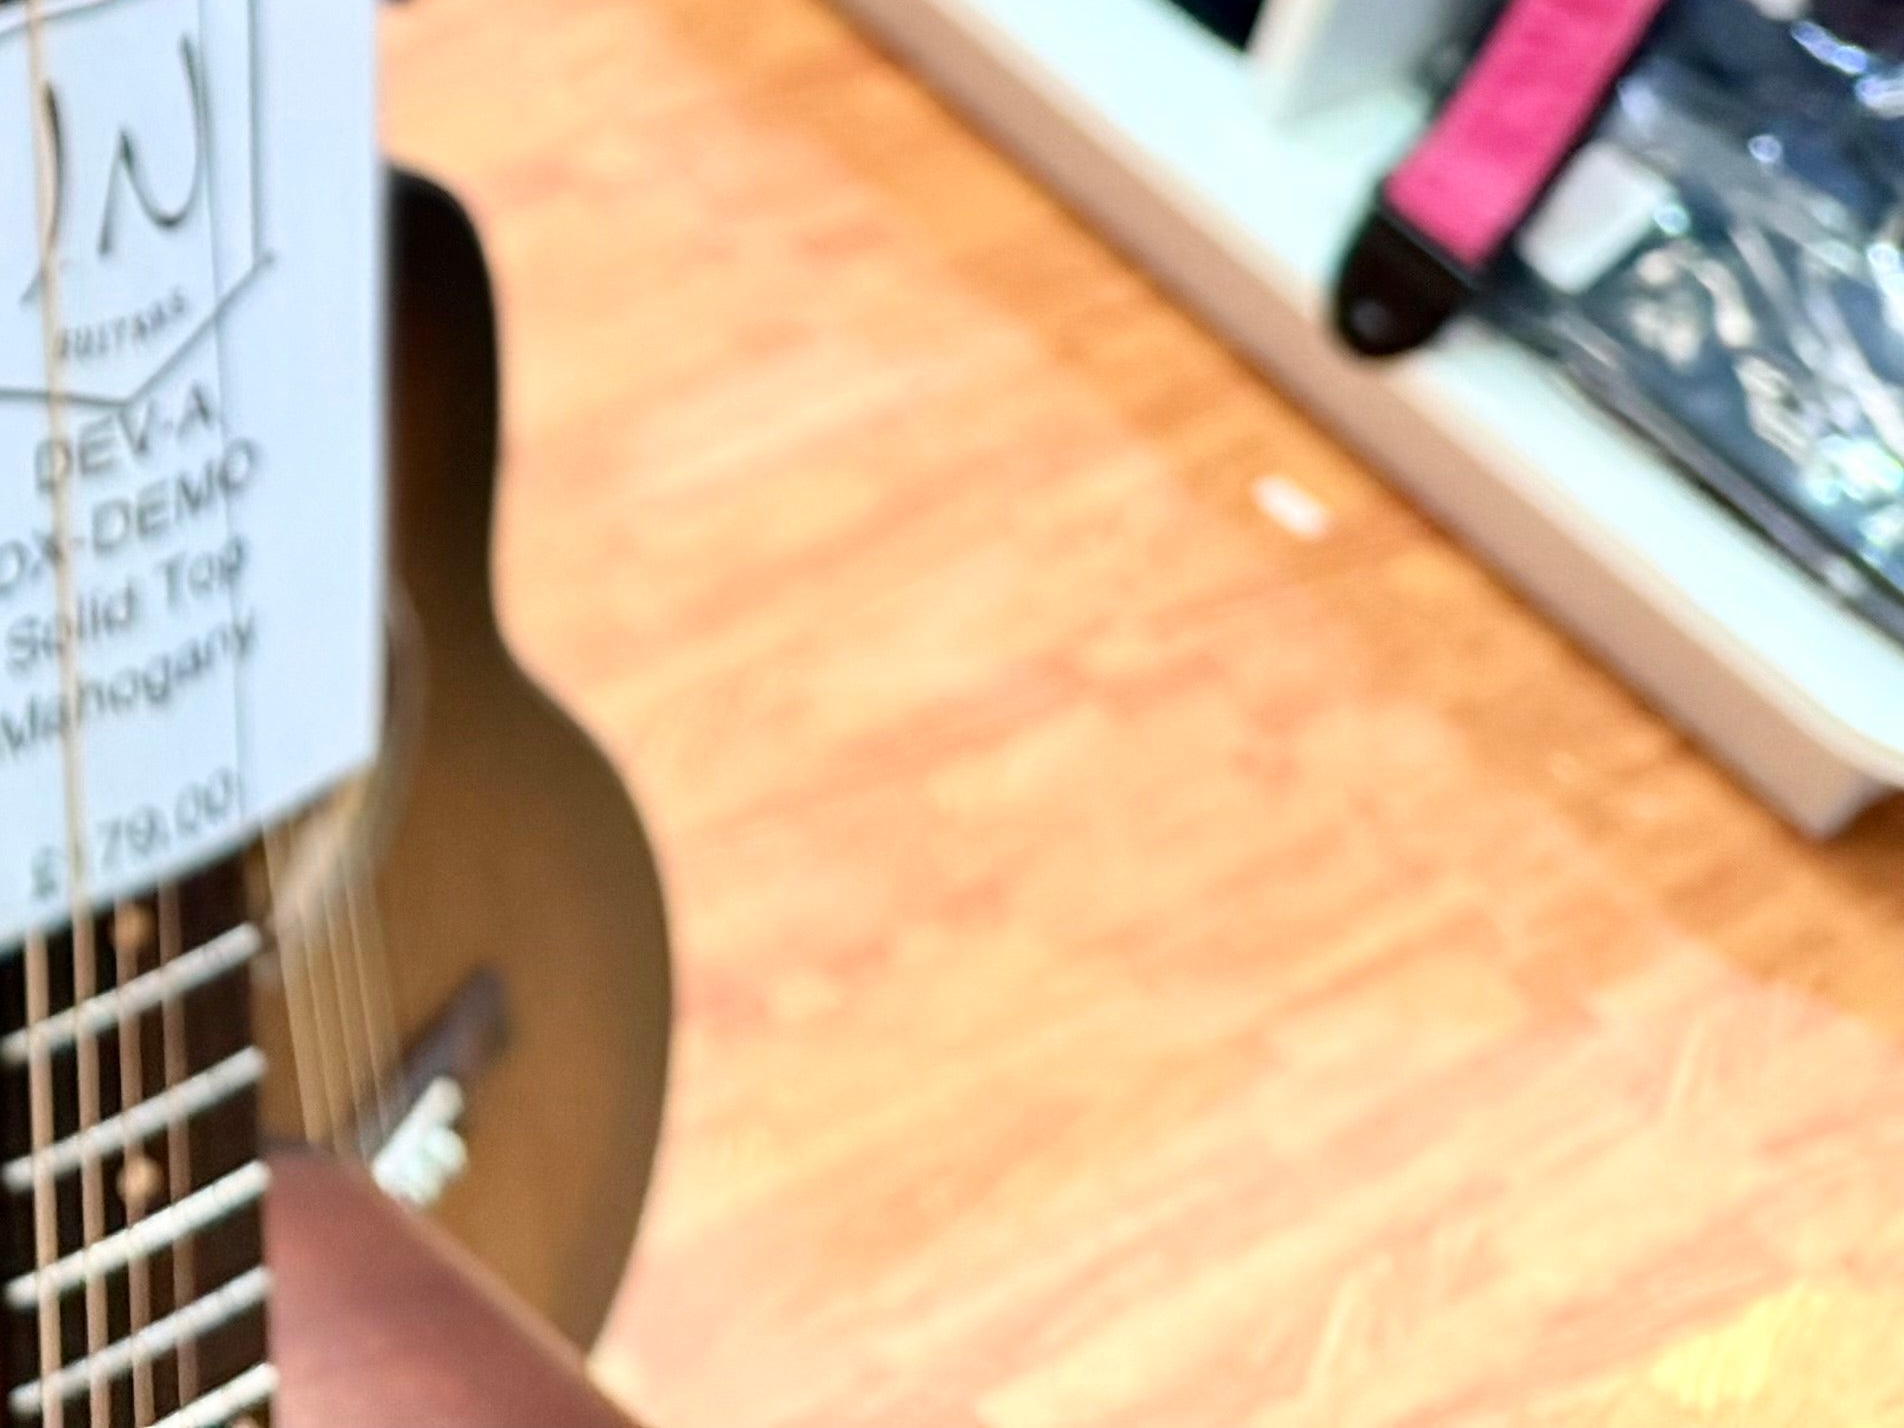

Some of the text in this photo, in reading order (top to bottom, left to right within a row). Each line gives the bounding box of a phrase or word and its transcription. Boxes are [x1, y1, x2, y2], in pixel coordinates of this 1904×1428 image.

[4, 534, 250, 678] Solid Top
[29, 764, 236, 904] £79.00
